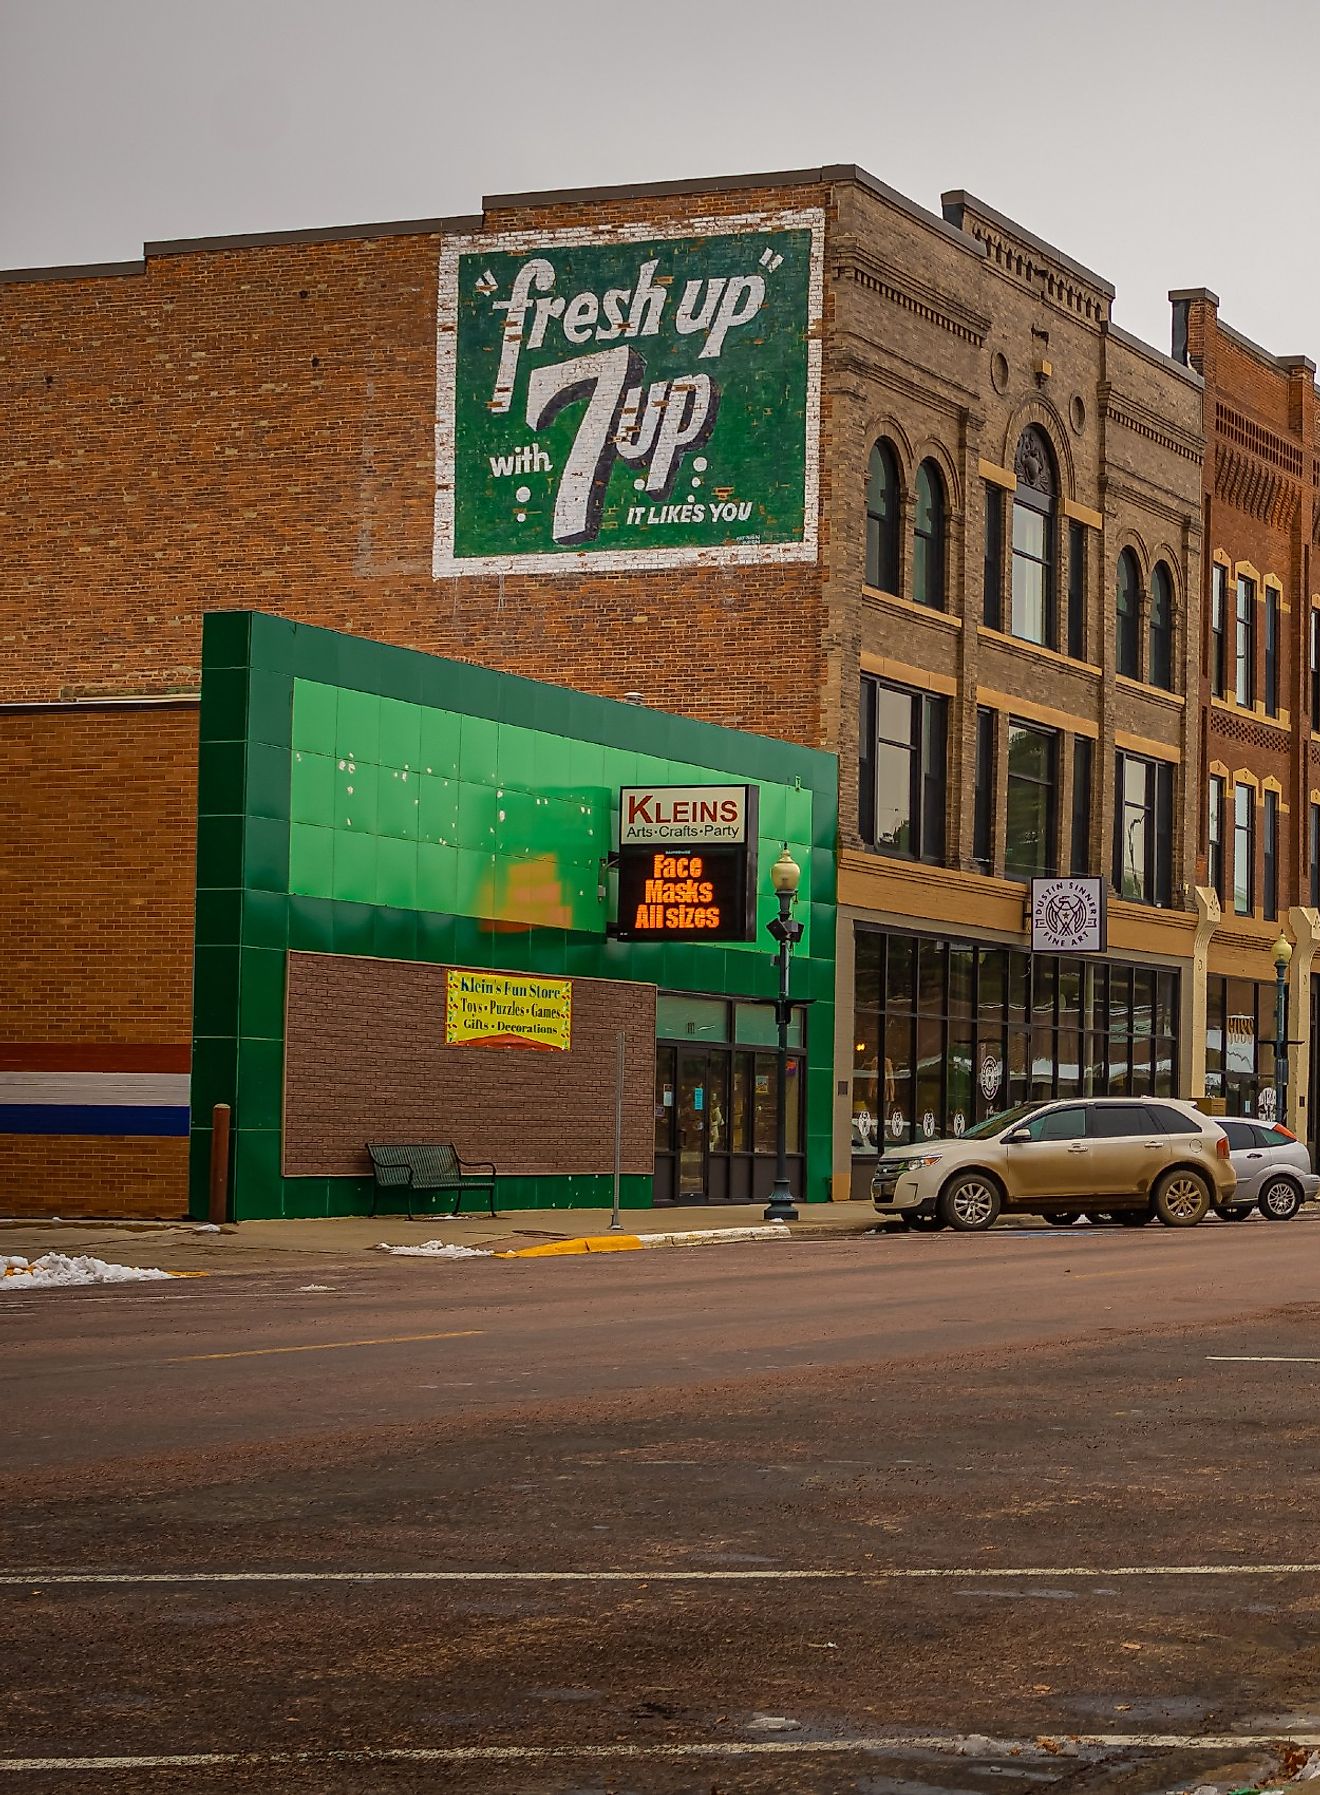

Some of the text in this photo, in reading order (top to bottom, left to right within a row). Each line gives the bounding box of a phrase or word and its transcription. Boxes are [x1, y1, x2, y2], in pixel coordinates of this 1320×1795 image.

[489, 442, 553, 477] with
[627, 501, 752, 525] IT LIKES YOU
[628, 795, 738, 824] KLEINS
[653, 854, 702, 878] Face
[645, 880, 714, 903] Masks
[1035, 882, 1097, 915] DUSTIN SINNER
[635, 904, 720, 929] All sizes
[1043, 930, 1089, 947] FINE ART
[460, 977, 561, 999] Klein's Fun Store
[461, 998, 561, 1019] Toys Puzzles Games
[463, 1018, 558, 1035] Gifts Decorations
